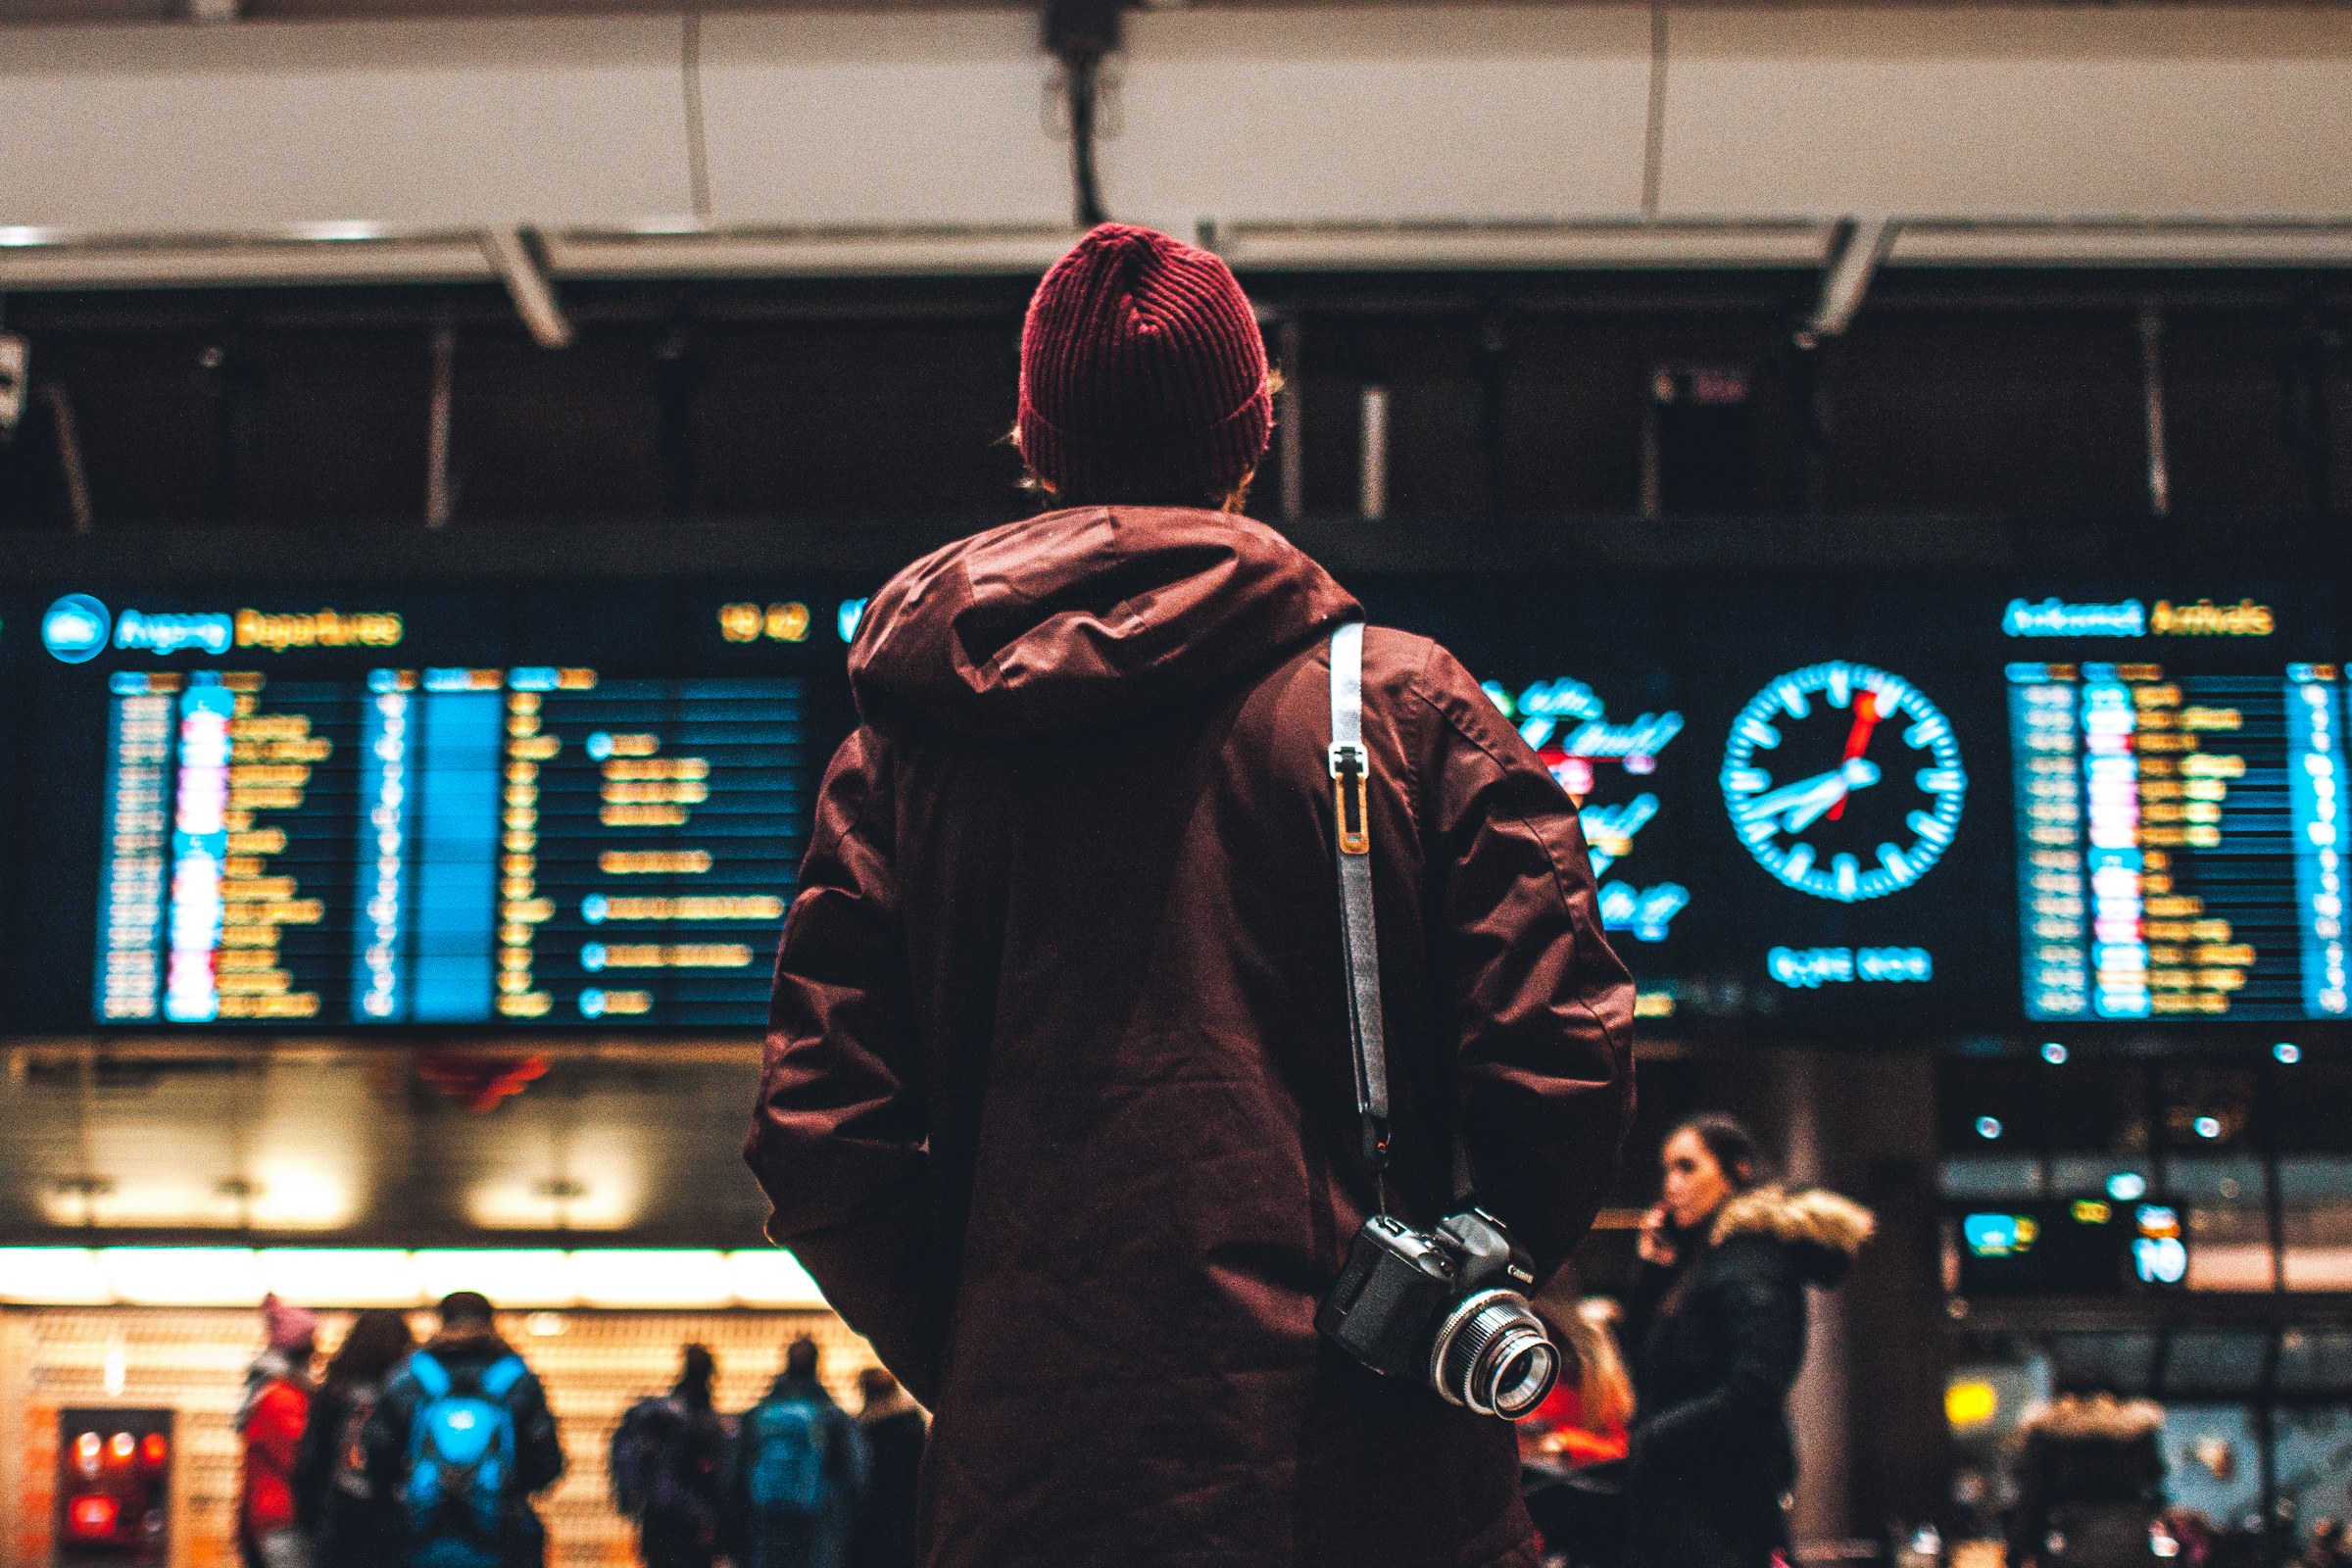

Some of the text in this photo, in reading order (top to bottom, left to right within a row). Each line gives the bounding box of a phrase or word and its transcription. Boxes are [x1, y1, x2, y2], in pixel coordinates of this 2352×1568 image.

[235, 608, 403, 653] Departures
[2152, 598, 2275, 636] Arrivals
[1507, 1263, 1535, 1285] Canon
